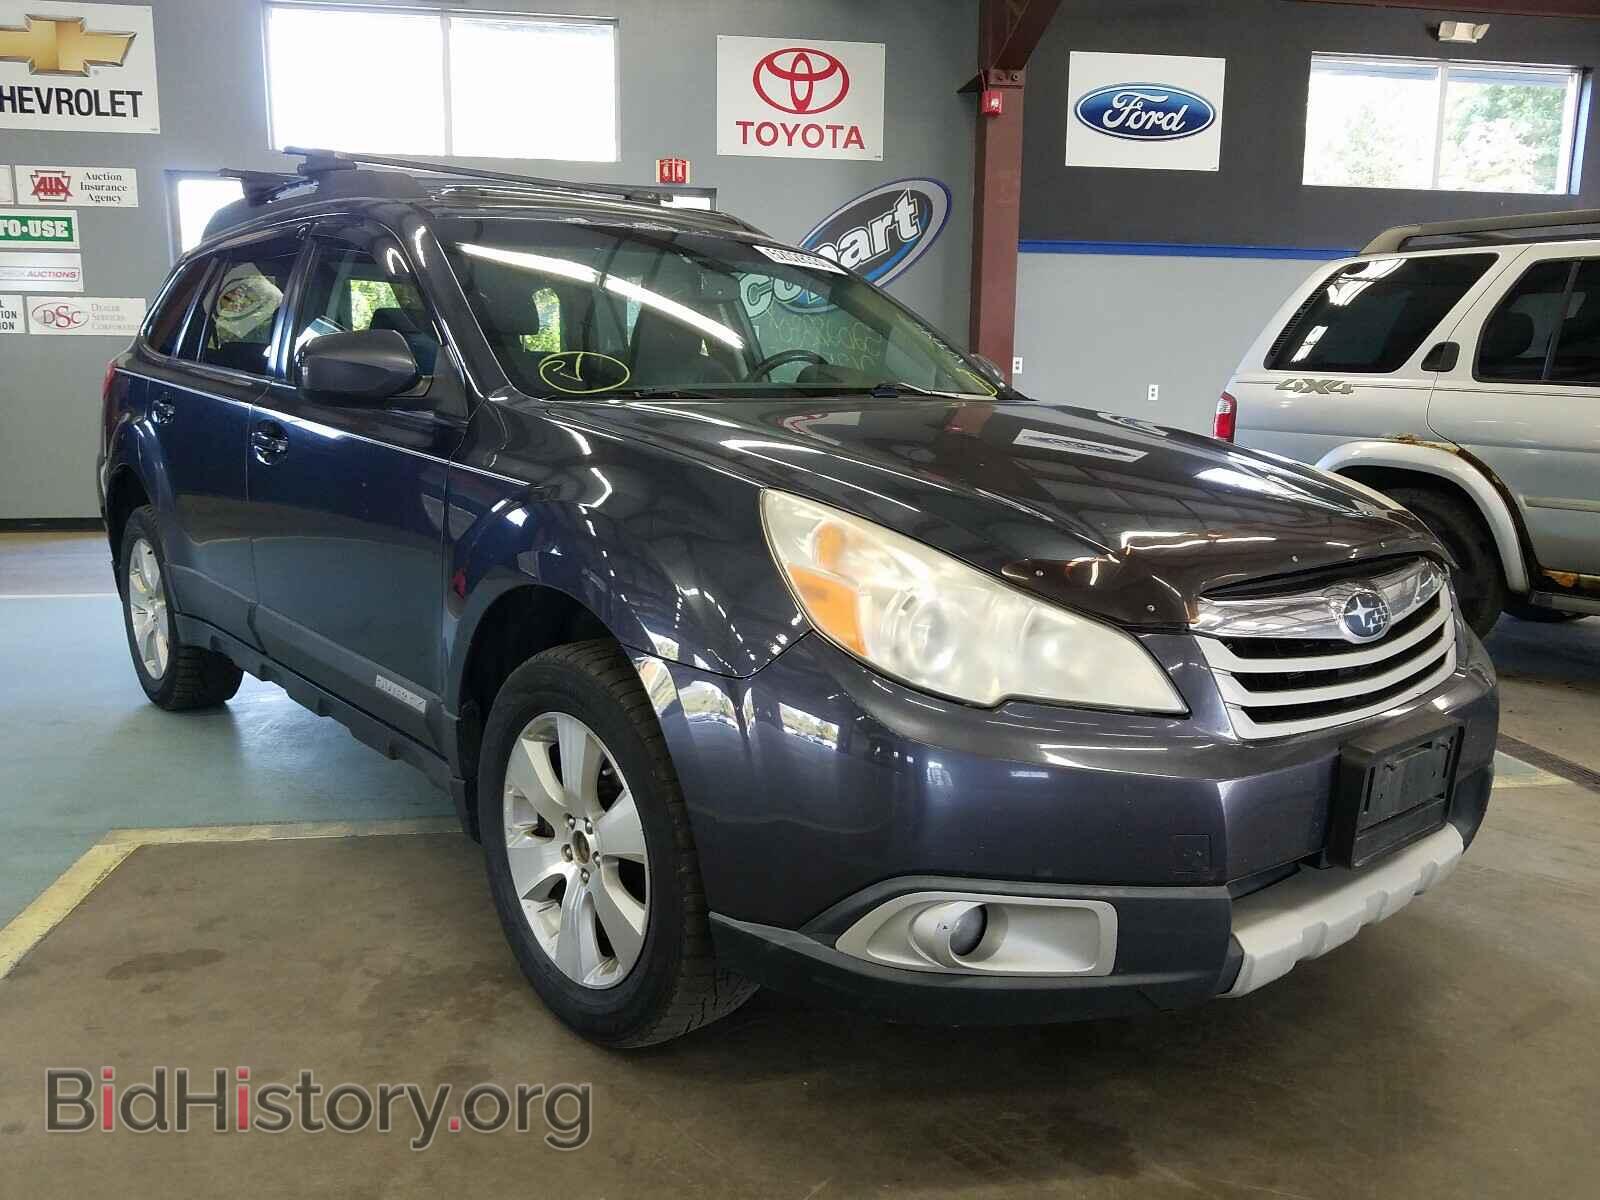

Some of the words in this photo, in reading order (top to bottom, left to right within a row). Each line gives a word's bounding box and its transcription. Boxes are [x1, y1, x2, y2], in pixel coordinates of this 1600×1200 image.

[1102, 92, 1189, 131] Ford
[736, 121, 866, 149] TOYOTA
[85, 172, 122, 181] Auction
[80, 182, 128, 192] Insurance
[88, 193, 121, 204] Agency
[27, 270, 77, 279] AUCTIONS
[42, 305, 81, 328] DSC
[1275, 378, 1354, 394] 4X4
